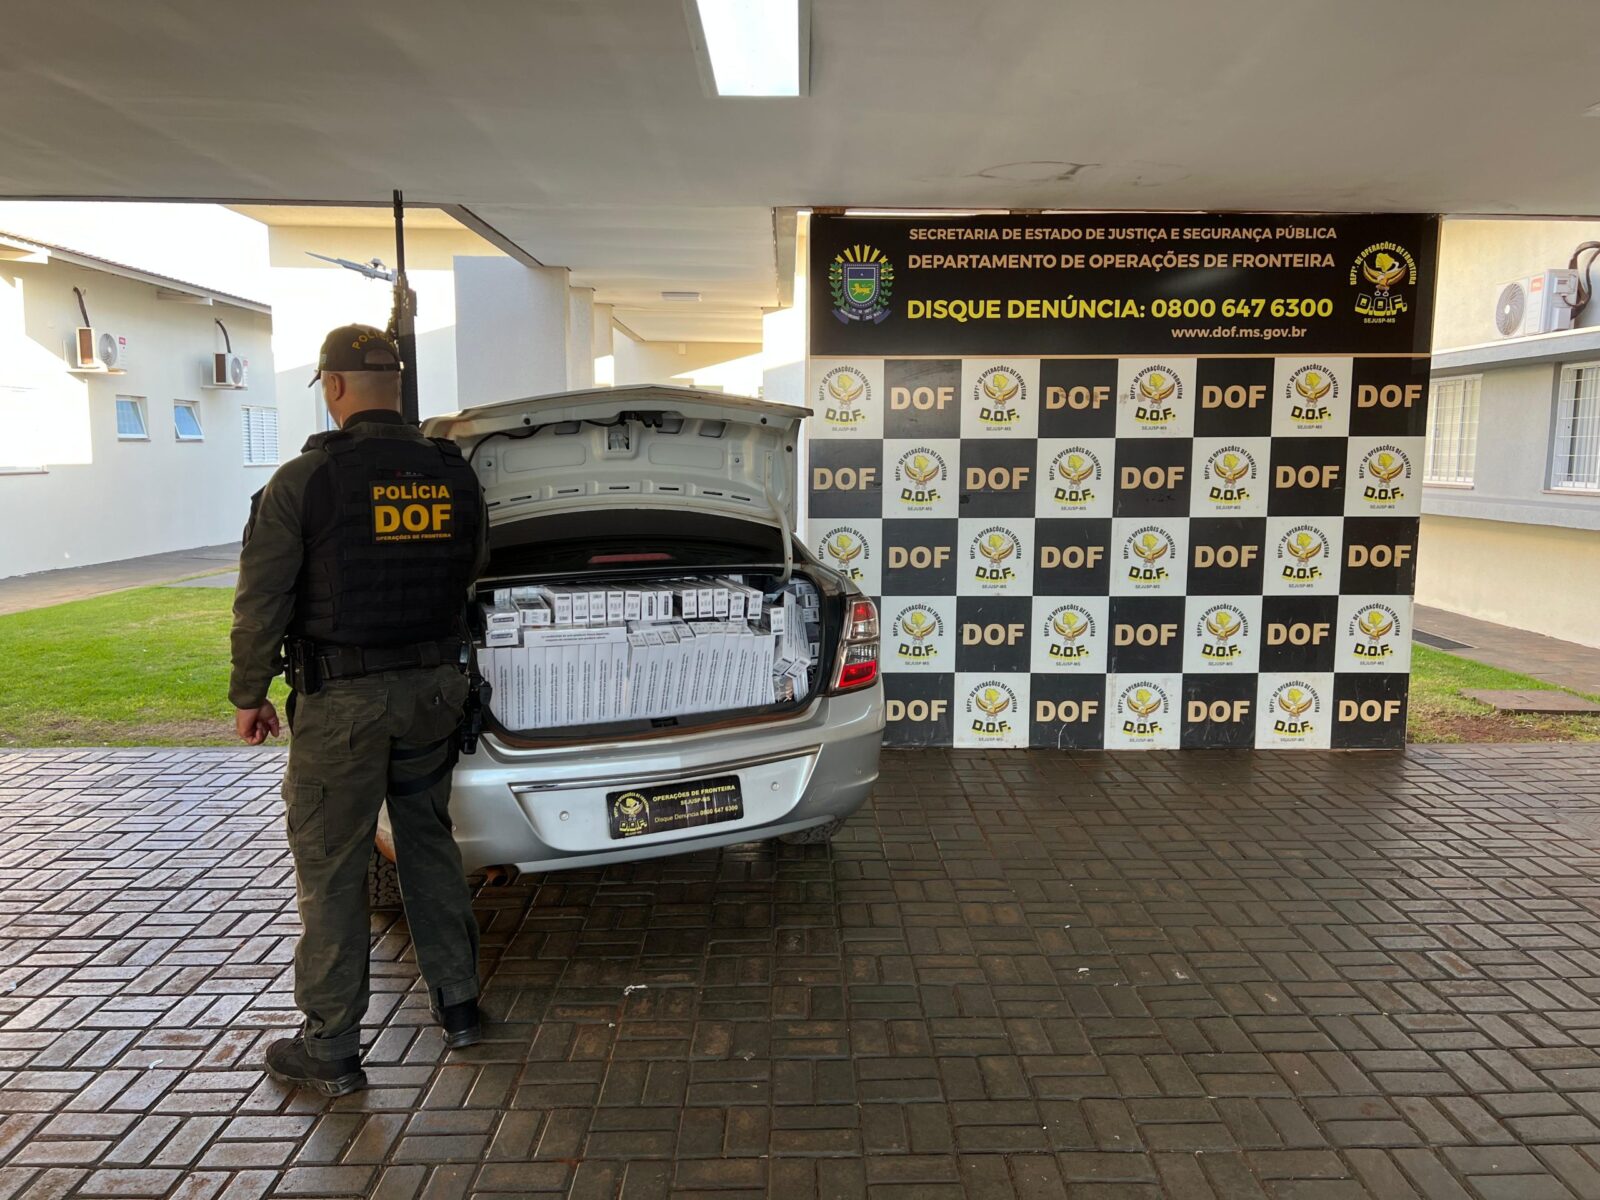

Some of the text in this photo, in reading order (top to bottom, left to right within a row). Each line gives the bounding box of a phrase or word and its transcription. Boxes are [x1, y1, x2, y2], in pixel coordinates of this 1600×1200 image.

[909, 224, 1337, 243] SECRETARIA DE ESTADO DE JUSTIÇA E SEGURANÇA PÚBLICA
[908, 250, 1336, 272] DEPARTAMENTO DE OPERAÇÕES DE FRONTEIRA
[1361, 241, 1397, 257] OPERAÇÕES
[1402, 252, 1417, 285] FRONTEIRA
[907, 294, 1334, 323] DISQUE DENÚNCIA: 0800 647 6300
[1171, 325, 1307, 341] www.dof.ms.gov.br
[889, 385, 956, 411] DOF
[1045, 385, 1111, 410] DOF
[1202, 385, 1267, 409] DOF
[1357, 384, 1423, 408] DOF
[825, 408, 865, 423] D.O.F.
[979, 408, 1020, 422] D.O.F.
[1135, 407, 1176, 422] D.O.F.
[1291, 406, 1331, 420] D.O.F.
[813, 467, 876, 491] DOF
[966, 466, 1030, 490] DOF
[1120, 466, 1185, 490] DOF
[1275, 465, 1340, 489] DOF
[372, 482, 450, 500] POLÍCIA
[901, 488, 941, 503] D.O.F.
[1054, 488, 1095, 502] D.O.F.
[1209, 487, 1250, 501] D.O.F.
[1364, 486, 1404, 500] D.O.F.
[374, 504, 452, 533] DOF
[888, 546, 950, 569] DOF
[1040, 545, 1104, 569] DOF
[1194, 545, 1258, 568] DOF
[1347, 544, 1412, 568] DOF
[975, 566, 1015, 580] D.O.F.
[1129, 566, 1169, 580] D.O.F.
[1282, 565, 1322, 579] D.O.F.
[962, 623, 1025, 646] DOF
[1114, 623, 1178, 646] DOF
[1266, 622, 1330, 646] DOF
[898, 644, 938, 657] D.O.F.
[1049, 644, 1089, 658] D.O.F.
[1202, 644, 1242, 658] D.O.F.
[1354, 643, 1393, 657] D.O.F.
[885, 698, 949, 722] DOF
[1035, 700, 1098, 723] DOF
[1187, 700, 1250, 723] DOF
[1338, 699, 1401, 723] DOF
[972, 720, 1011, 733] D.O.F.
[1123, 721, 1162, 734] D.O.F.
[1274, 720, 1313, 734] D.O.F.
[652, 791, 690, 802] OPERAÇÕES
[700, 784, 736, 794] FRONTEIRA
